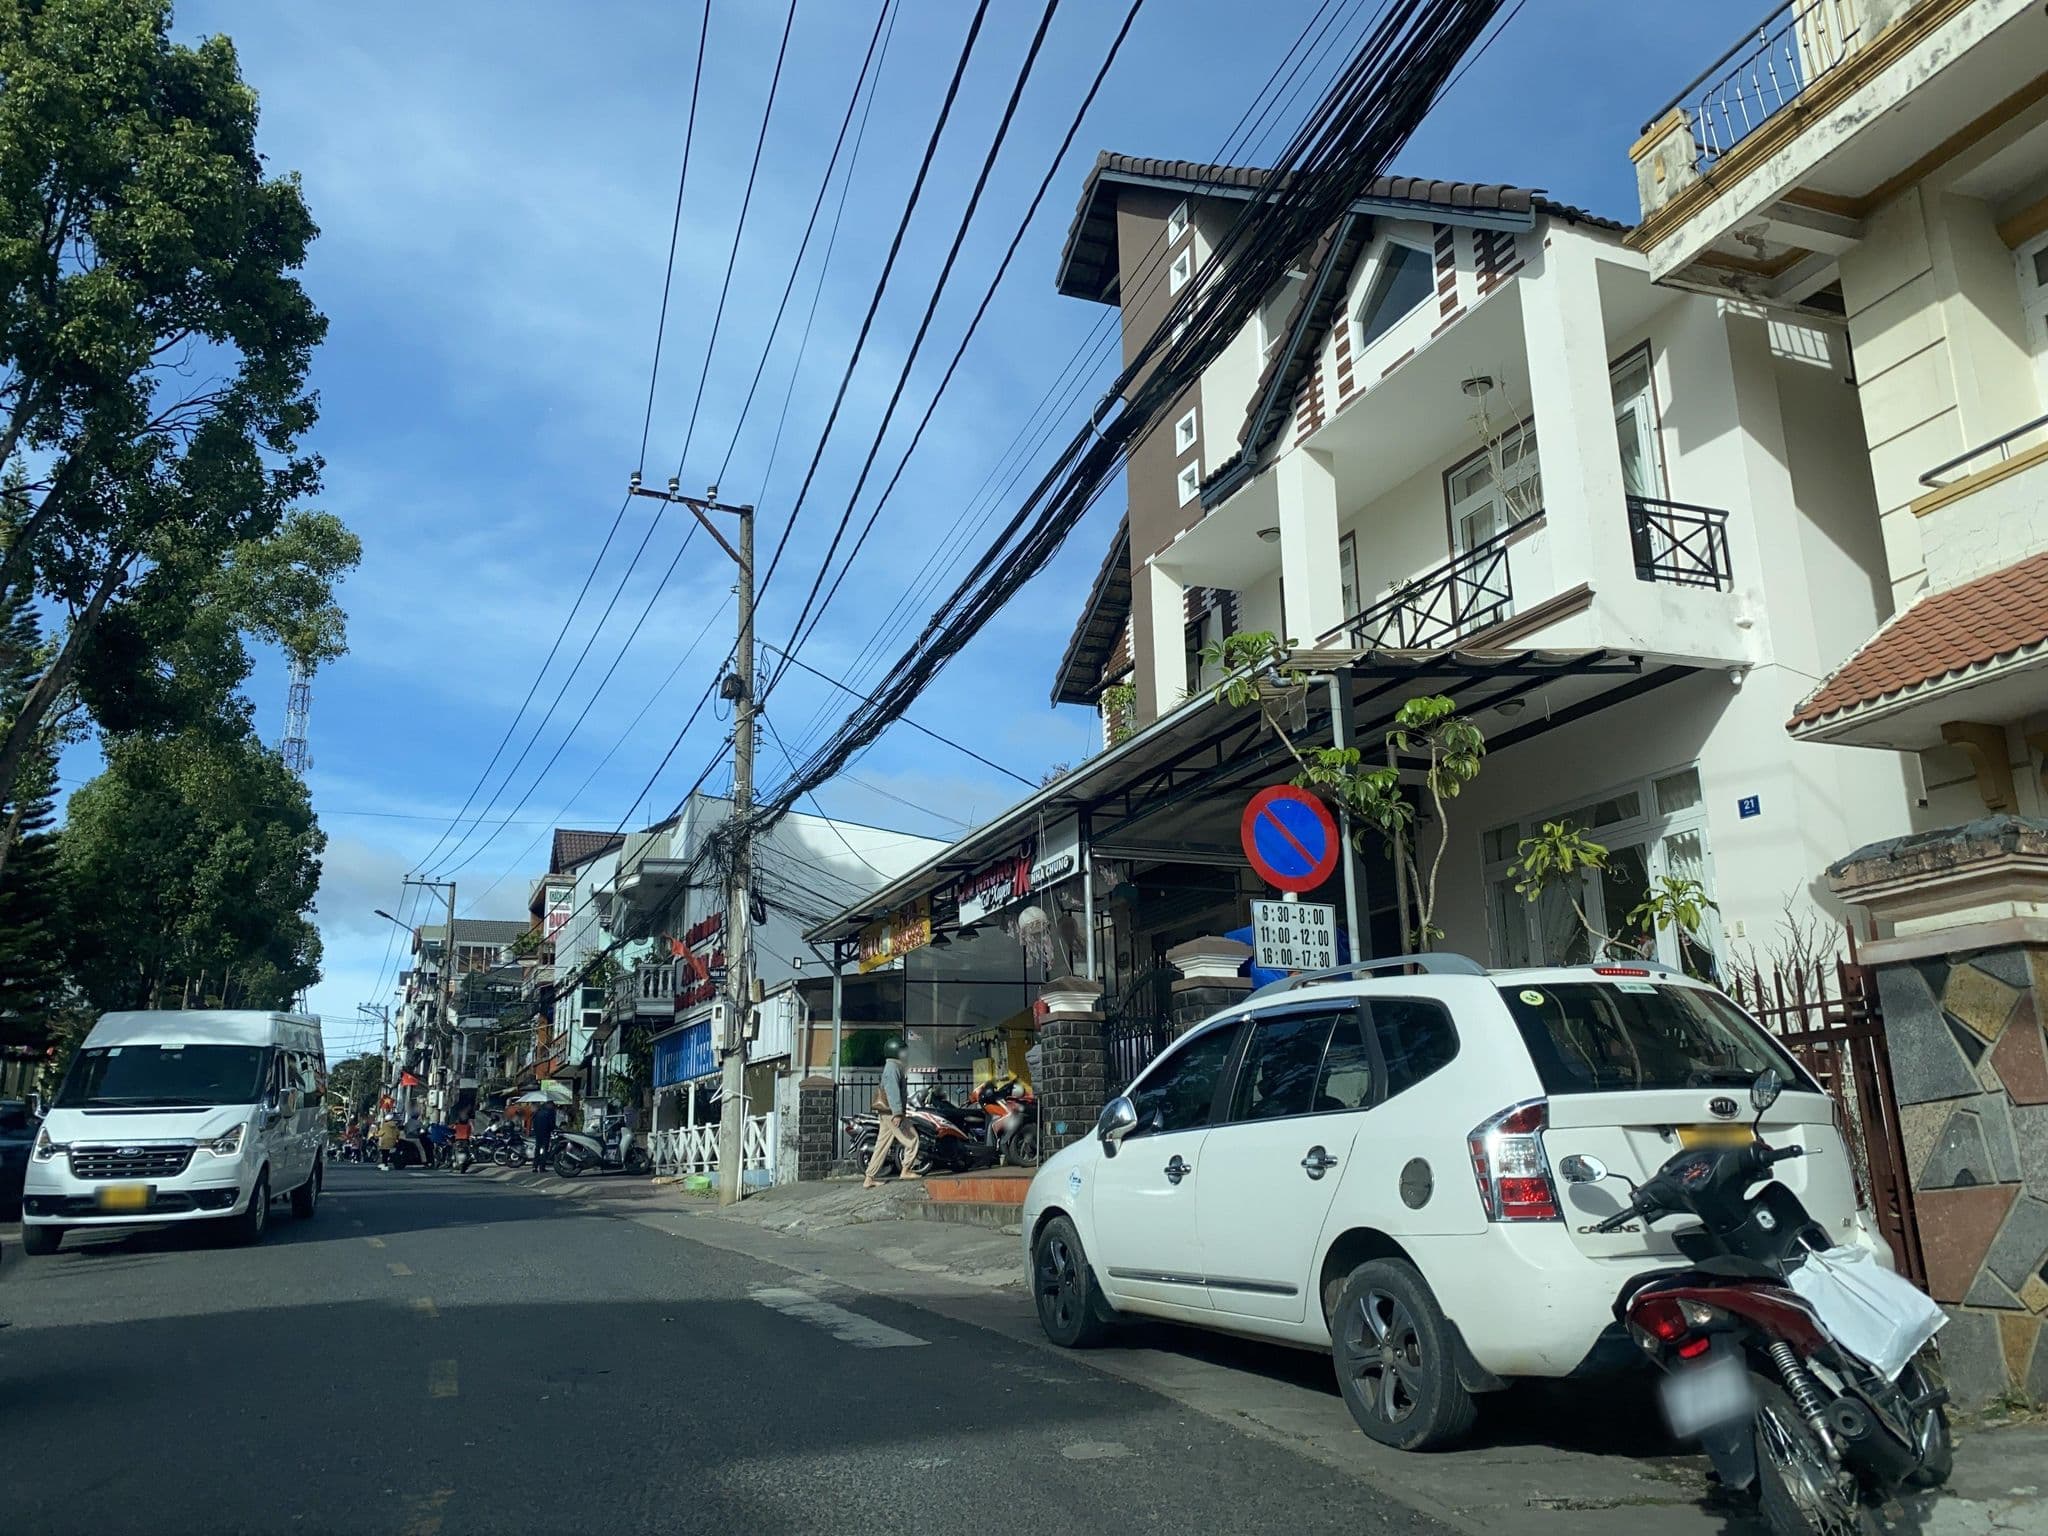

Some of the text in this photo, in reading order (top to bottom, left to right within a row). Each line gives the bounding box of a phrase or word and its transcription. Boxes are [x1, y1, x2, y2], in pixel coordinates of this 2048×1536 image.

[1743, 799, 1755, 810] 21
[1046, 854, 1071, 877] CHUNG
[1711, 1100, 1737, 1113] KIA
[1577, 1224, 1641, 1234] CAENS
